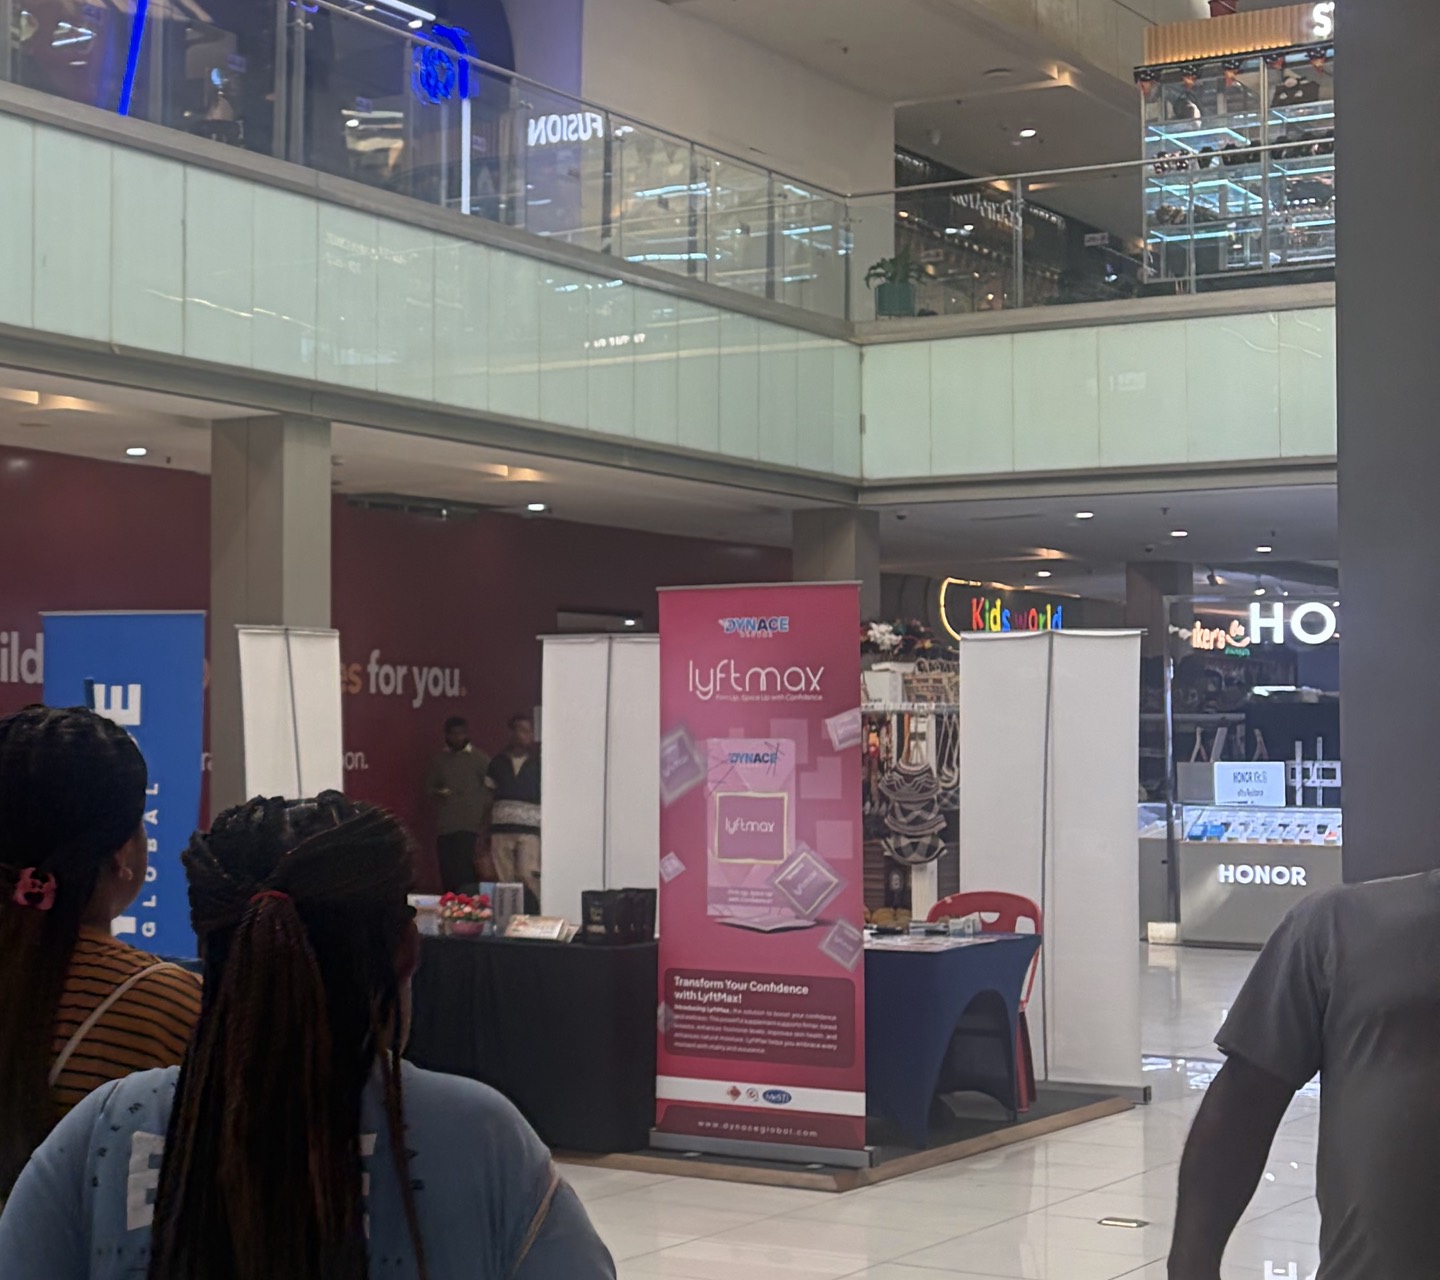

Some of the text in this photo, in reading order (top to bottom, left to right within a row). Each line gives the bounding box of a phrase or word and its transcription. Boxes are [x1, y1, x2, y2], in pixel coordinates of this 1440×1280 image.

[971, 597, 1011, 632] Kids
[367, 649, 408, 695] for
[689, 659, 825, 701] lyftmax
[341, 752, 369, 770] on.
[725, 817, 775, 835] lyftmax
[141, 783, 159, 938] GLOBAL
[1218, 863, 1307, 886] HONOR
[674, 976, 809, 995] Transform Your Confidence
[674, 990, 743, 1004] with LyftMax!
